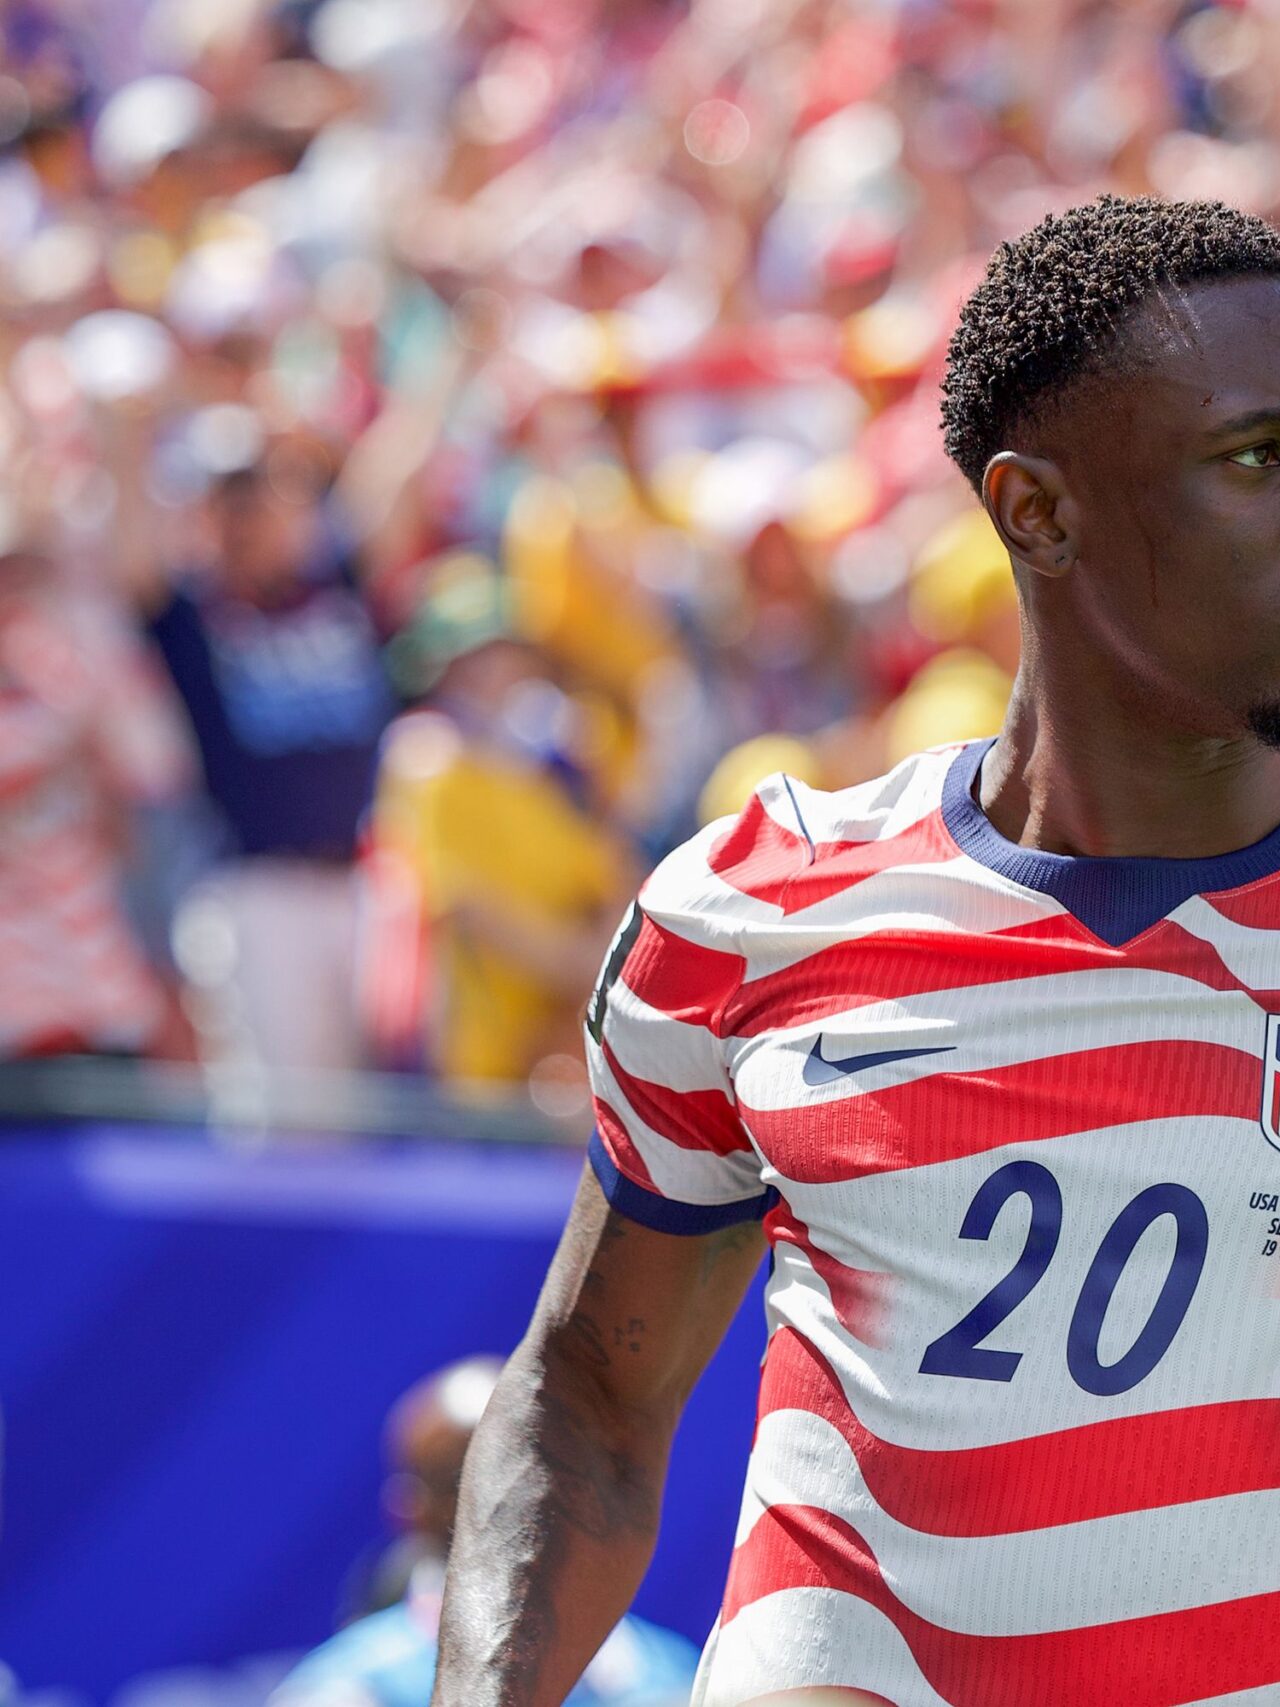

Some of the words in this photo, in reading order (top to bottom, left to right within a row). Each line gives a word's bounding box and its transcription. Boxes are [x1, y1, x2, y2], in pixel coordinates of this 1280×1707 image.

[1249, 1192, 1280, 1212] USA
[1261, 1238, 1279, 1257] 19
[918, 1160, 1209, 1396] 20
